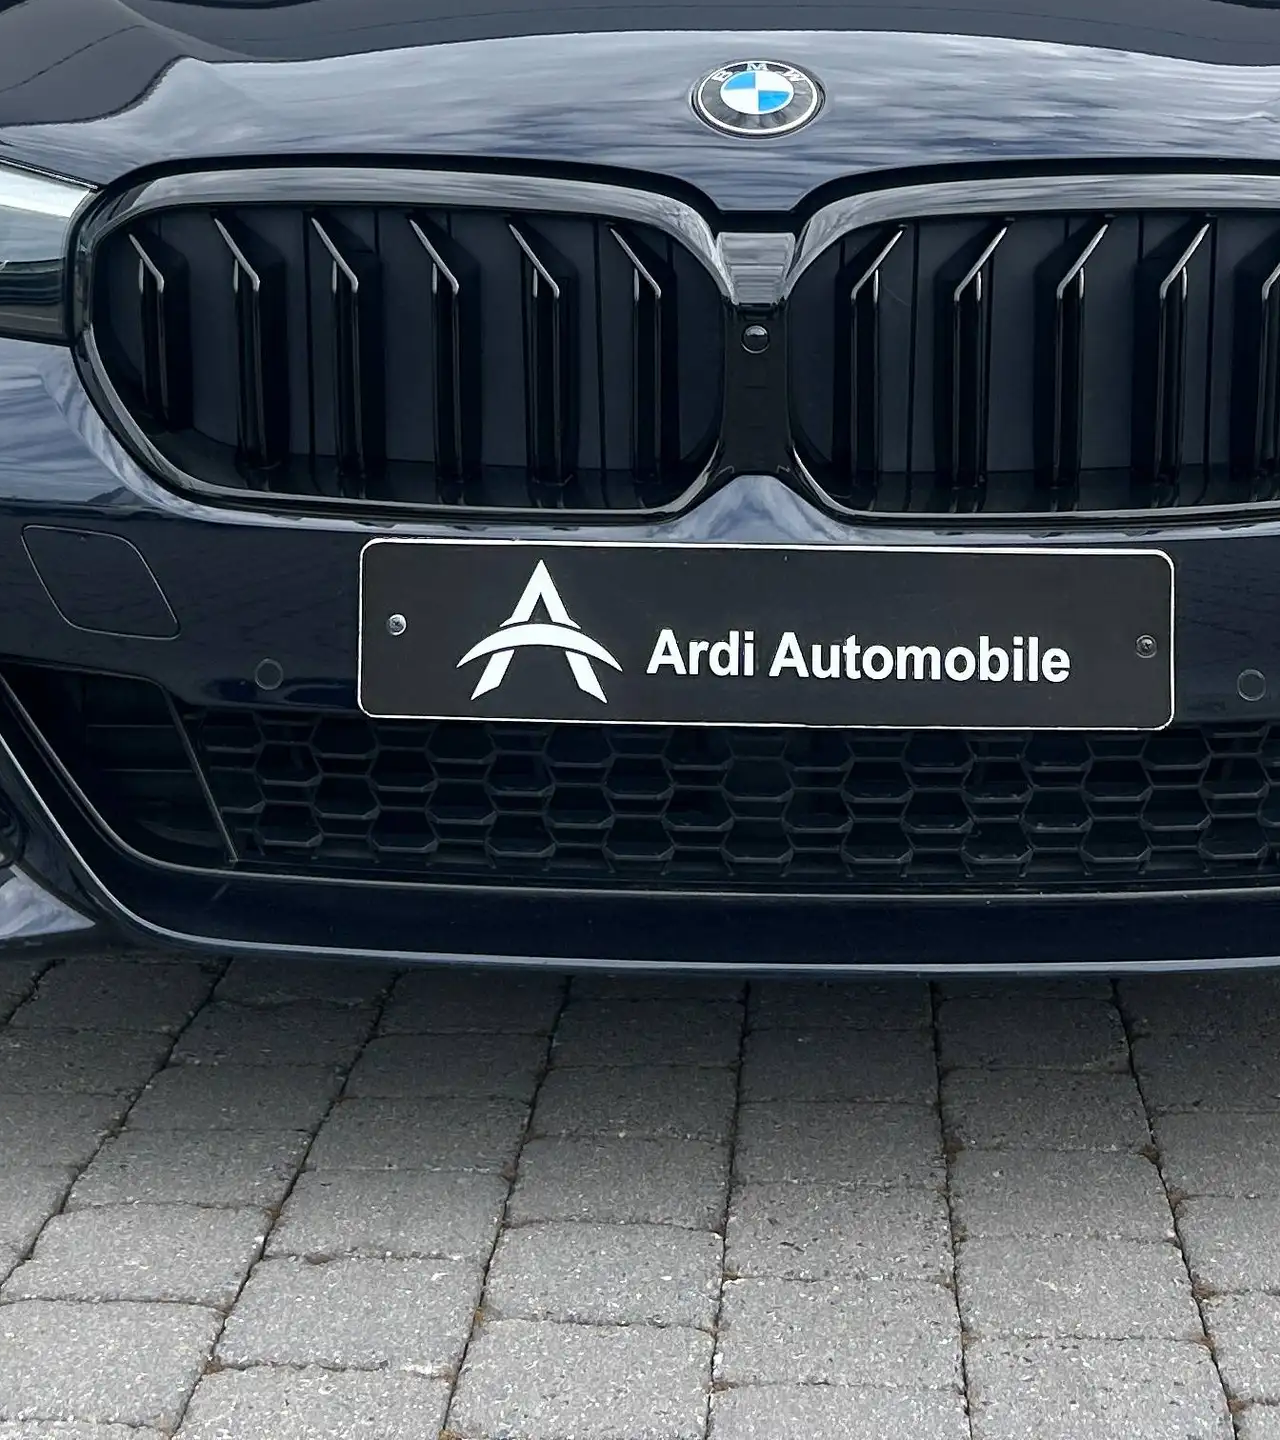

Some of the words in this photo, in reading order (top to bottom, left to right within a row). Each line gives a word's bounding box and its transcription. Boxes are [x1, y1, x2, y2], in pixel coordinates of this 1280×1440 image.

[711, 62, 806, 82] BMW
[646, 628, 755, 677] Ardi
[769, 631, 1071, 683] Automobile
